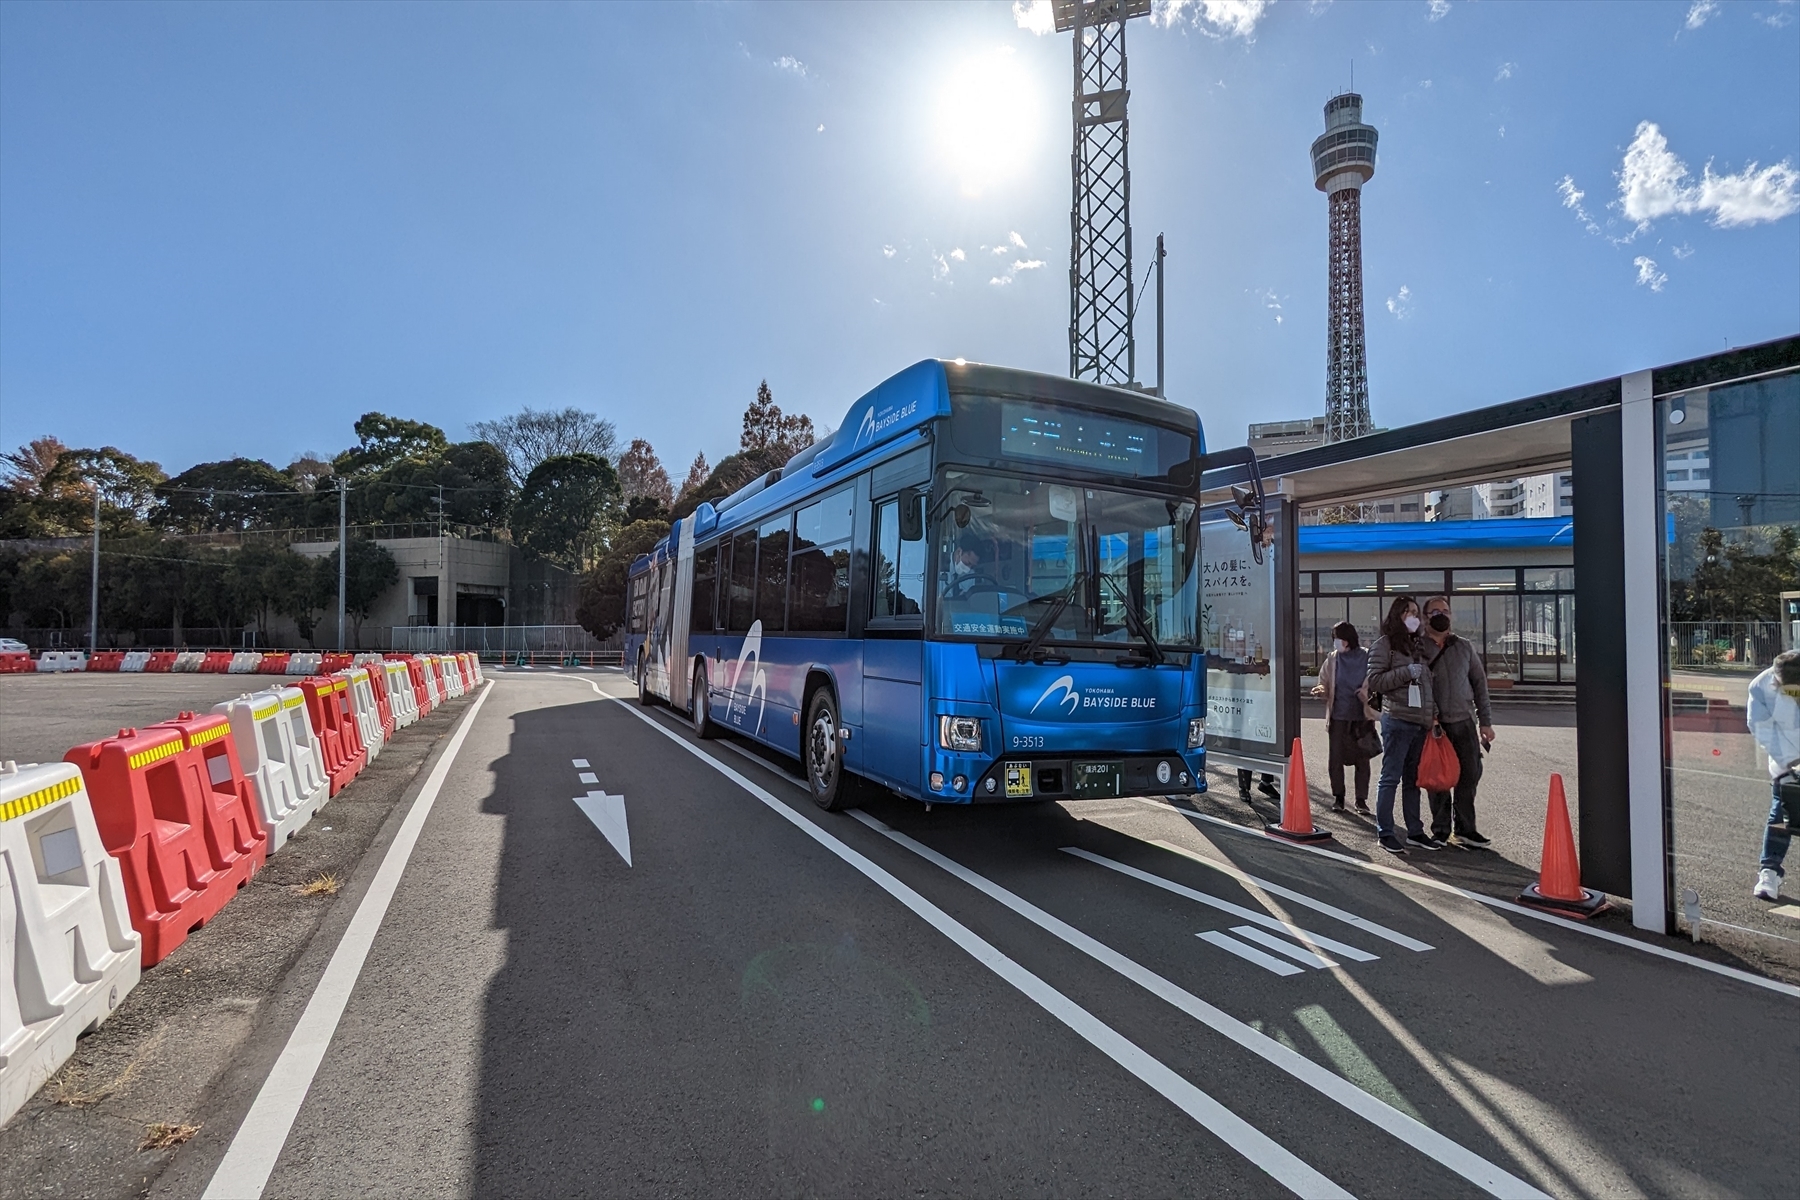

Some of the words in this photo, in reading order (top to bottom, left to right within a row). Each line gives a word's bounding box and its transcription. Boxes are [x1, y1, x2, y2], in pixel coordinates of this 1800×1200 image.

[875, 409, 900, 432] BAYSIDE
[900, 400, 917, 418] BLUE
[1203, 559, 1251, 574] 大人の髪に、
[1204, 575, 1251, 588] スパイスを。
[954, 623, 1025, 635] 交通安全運動実施中
[1083, 697, 1128, 708] BAYSIDE
[1131, 697, 1156, 708] BLUE
[1213, 705, 1242, 715] ROOTH
[1012, 736, 1044, 748] 9-3513
